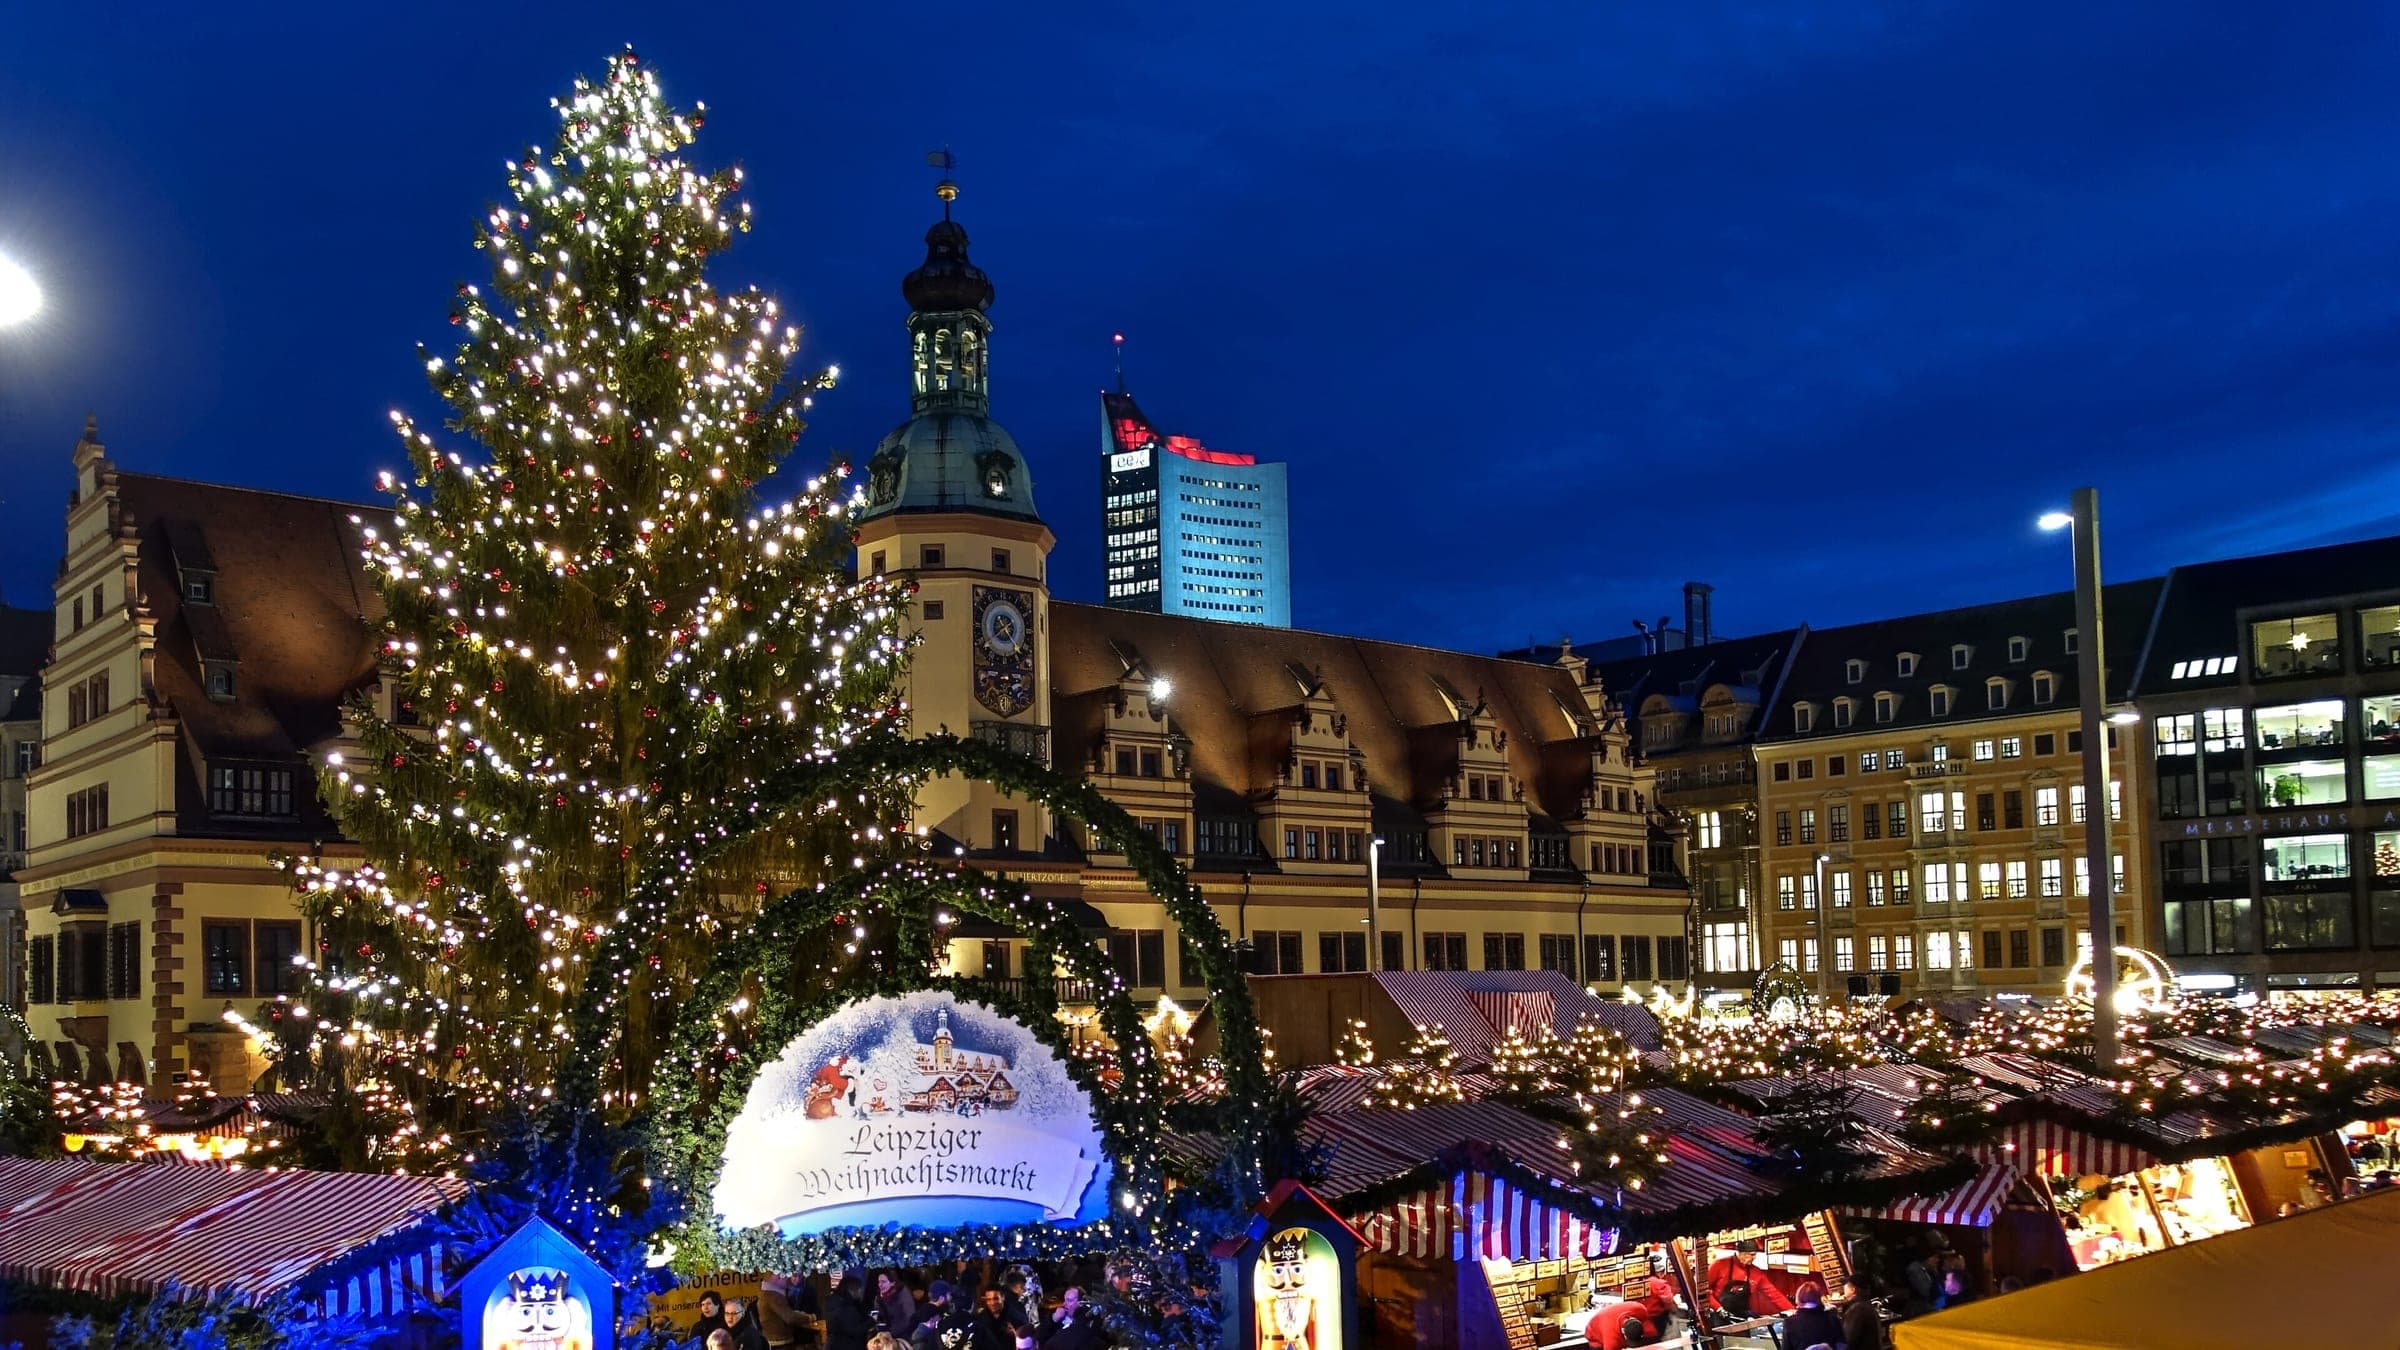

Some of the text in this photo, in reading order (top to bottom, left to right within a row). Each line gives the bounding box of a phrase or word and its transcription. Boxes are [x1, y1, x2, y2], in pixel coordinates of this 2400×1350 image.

[2185, 812, 2349, 835] MESSEHAUS
[844, 1122, 982, 1160] Leipziger
[796, 1154, 1038, 1198] Weihnachtsmarkt
